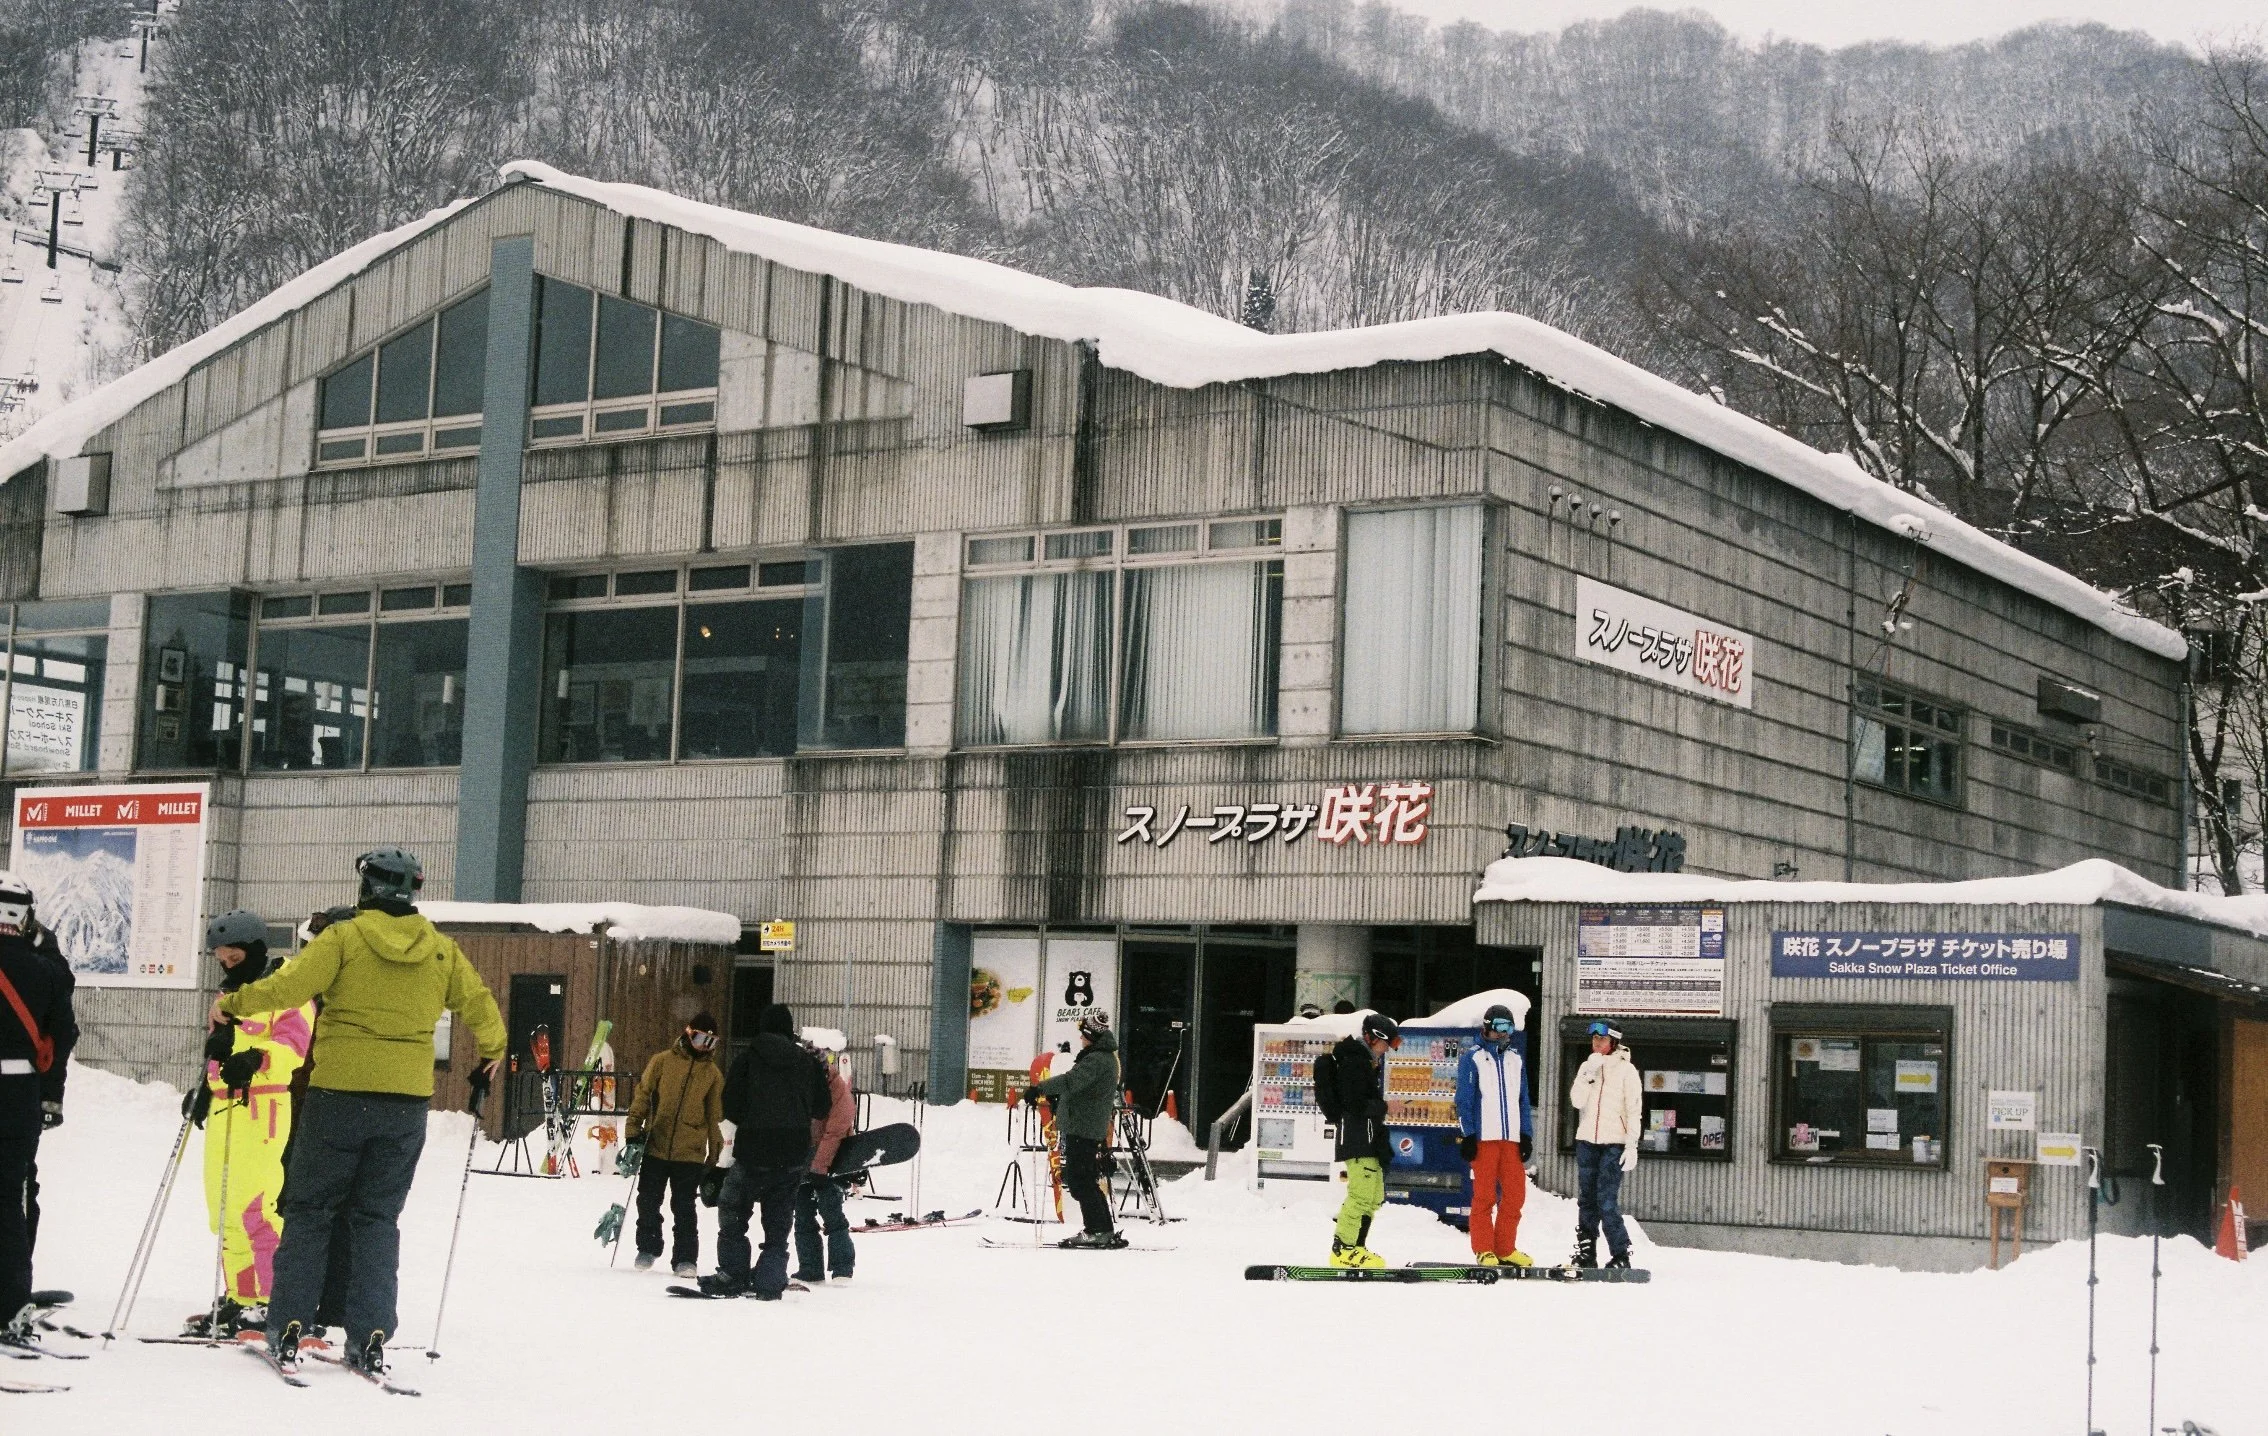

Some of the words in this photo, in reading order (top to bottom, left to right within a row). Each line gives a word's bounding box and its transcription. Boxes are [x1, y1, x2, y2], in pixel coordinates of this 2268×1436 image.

[1589, 608, 1744, 693] スノープラザ咲花
[65, 804, 103, 818] MILLET
[157, 801, 198, 815] MILLET
[1117, 780, 1434, 847] スノープラザ咲花
[1782, 937, 1820, 957] 咲花
[1825, 937, 1936, 957] スノープラザ
[1941, 938, 2069, 960] チケット売り場
[1829, 962, 1865, 974] Sakka
[1868, 962, 1902, 974] Snow
[1905, 963, 1938, 975] Plaza
[1940, 963, 1978, 975] Ticket
[1980, 963, 2018, 976] Office
[1056, 1008, 1081, 1017] BEARS
[1083, 1007, 1102, 1016] CAFE
[2015, 1107, 2029, 1116] UP
